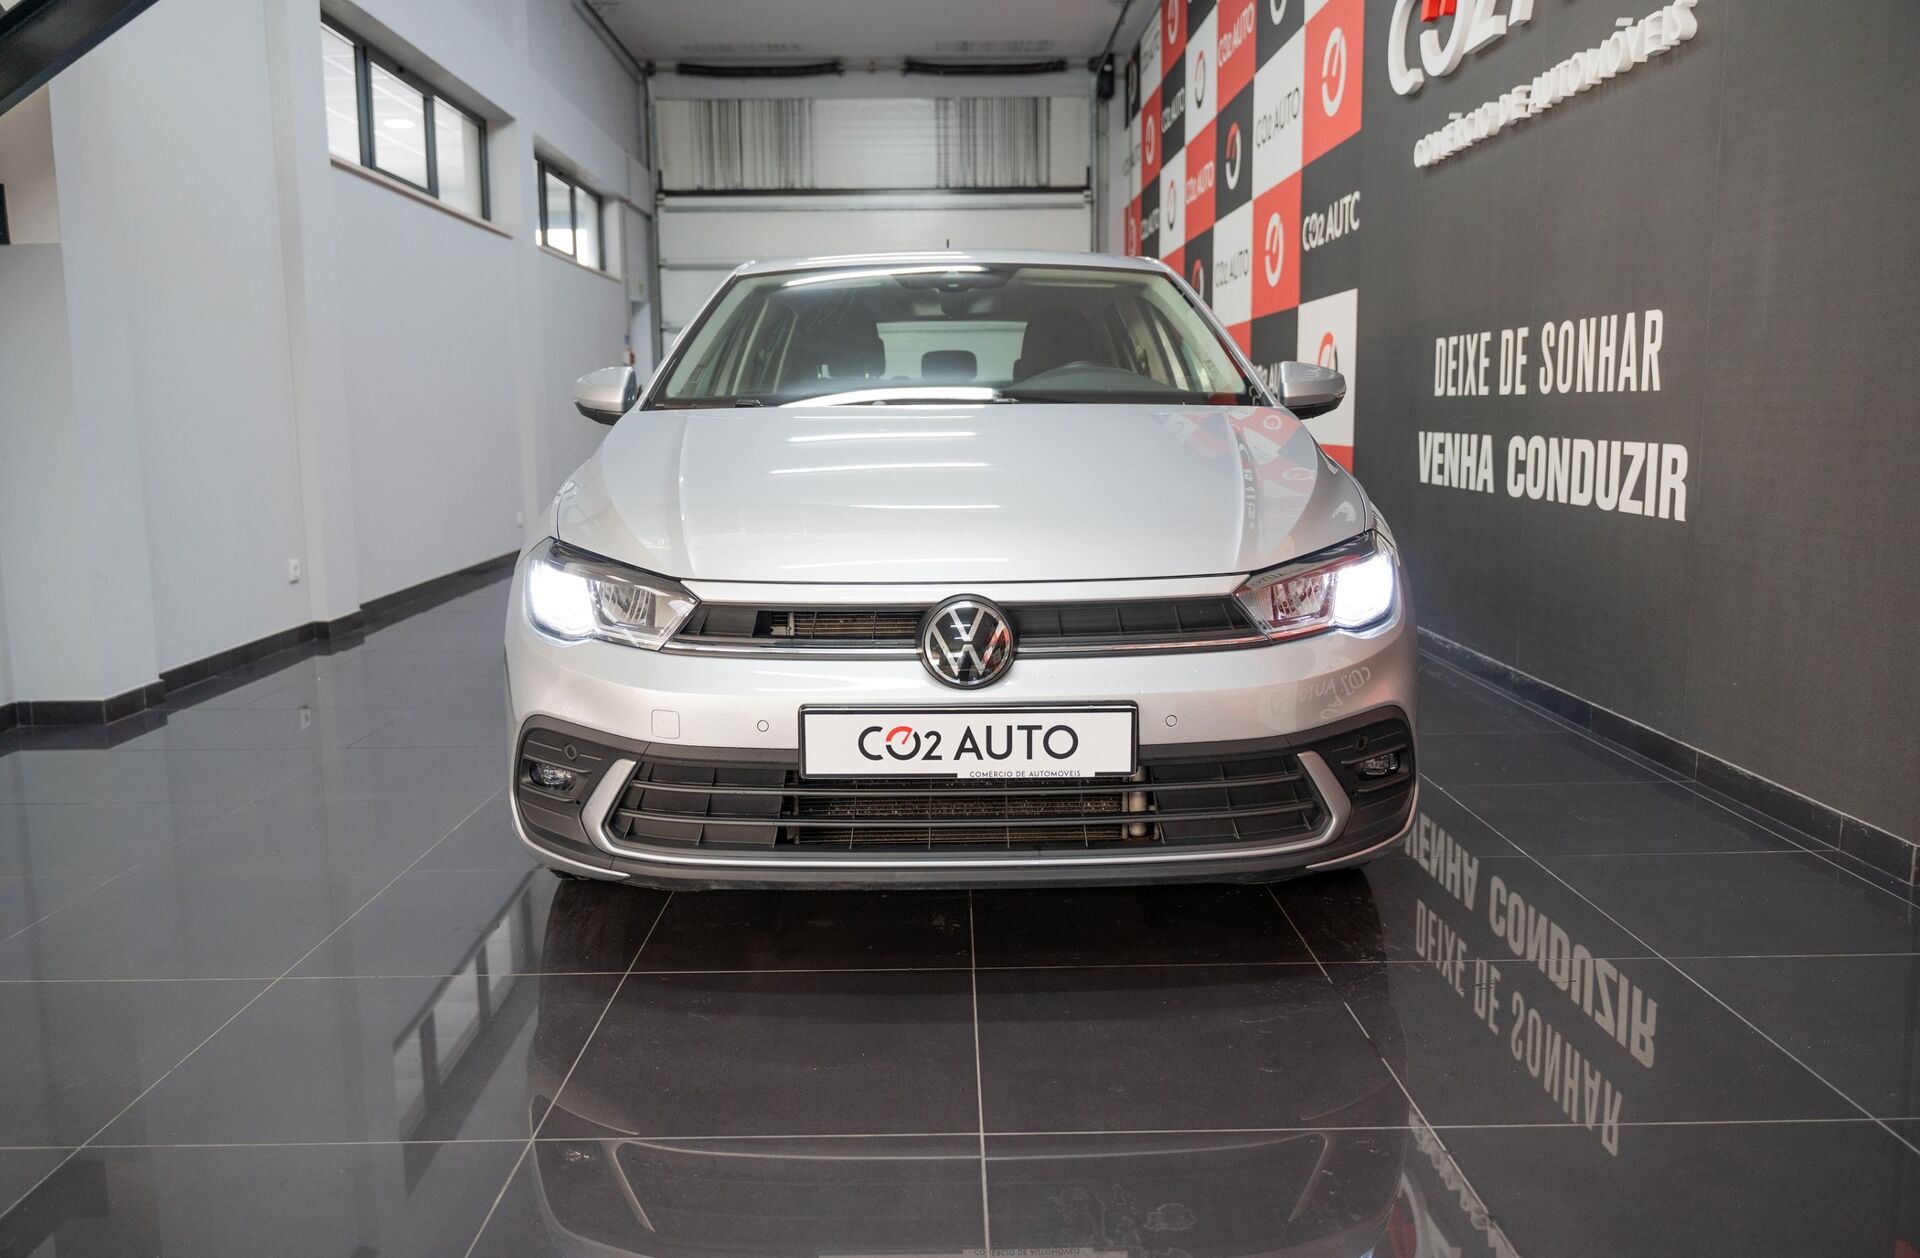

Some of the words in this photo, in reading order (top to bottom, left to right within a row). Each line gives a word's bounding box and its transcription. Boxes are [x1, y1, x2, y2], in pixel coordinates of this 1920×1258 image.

[1274, 87, 1300, 133] AUTO
[1302, 215, 1325, 251] CO2
[1434, 331, 1491, 397] DEIXE
[1499, 327, 1529, 395] DE
[1539, 309, 1663, 395] SONHAR
[1418, 431, 1494, 494] VENHA
[1507, 435, 1688, 522] CONDUZIR
[858, 725, 943, 761] CO2
[953, 725, 1079, 761] AUTO
